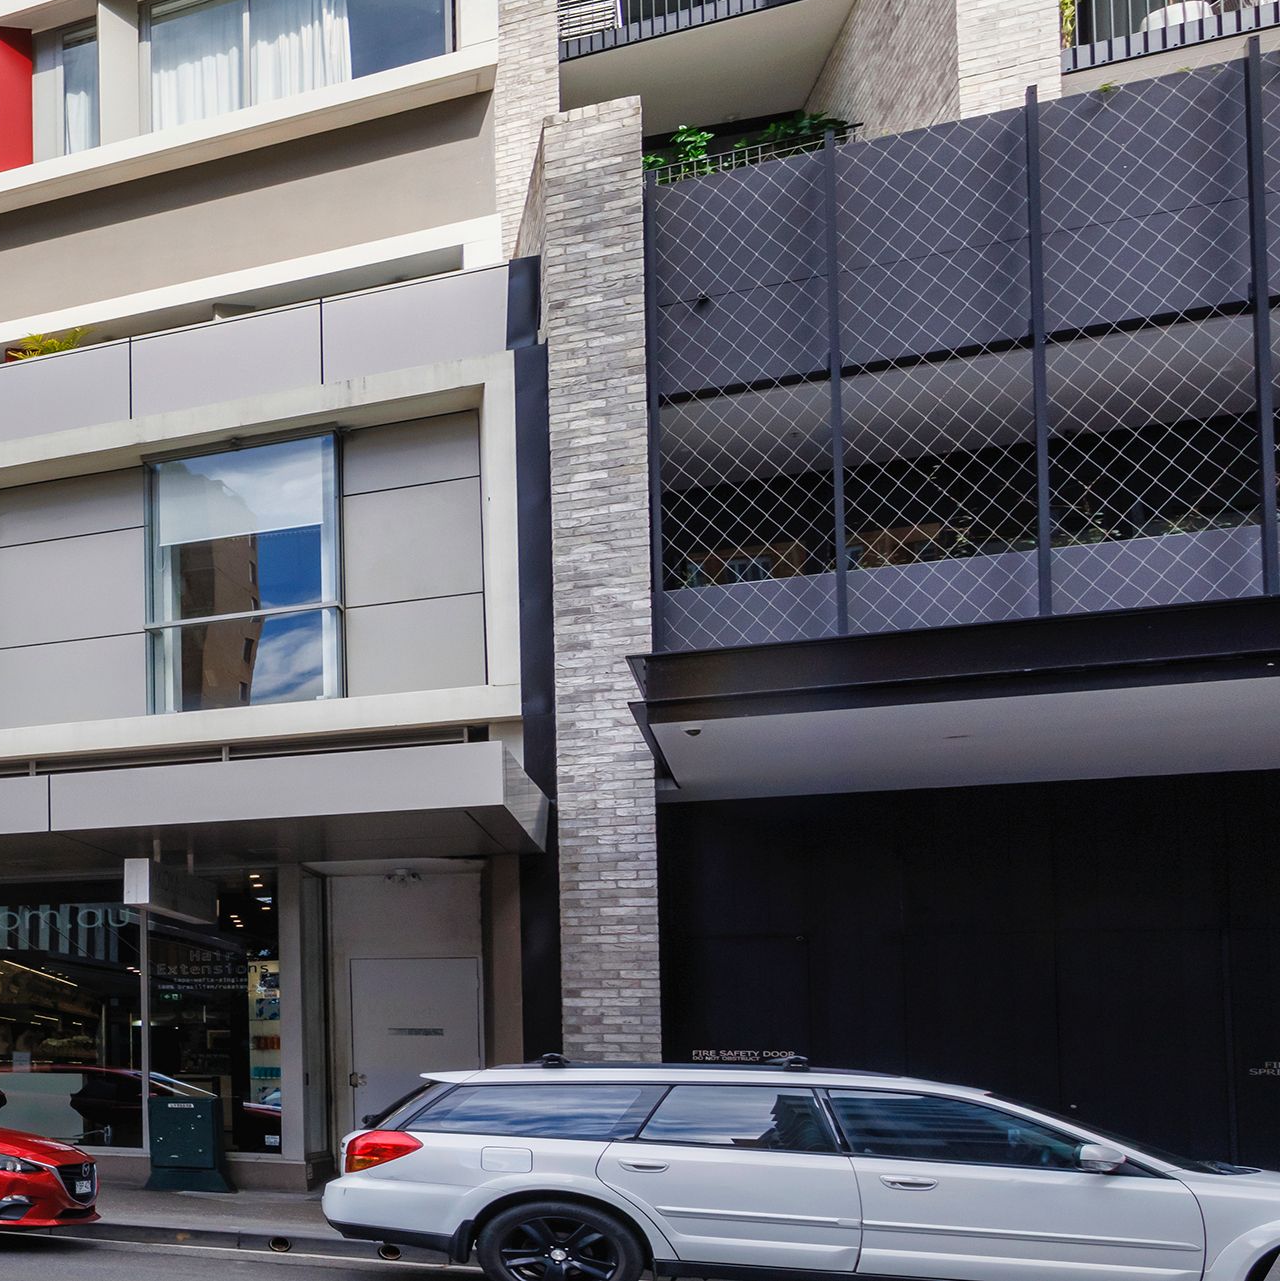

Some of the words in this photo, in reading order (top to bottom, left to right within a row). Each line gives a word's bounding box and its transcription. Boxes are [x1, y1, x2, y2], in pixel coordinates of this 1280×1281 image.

[190, 950, 235, 962] Hair
[156, 963, 269, 976] Extensions
[692, 1049, 716, 1057] FIRE
[1249, 1068, 1280, 1076] SPRI
